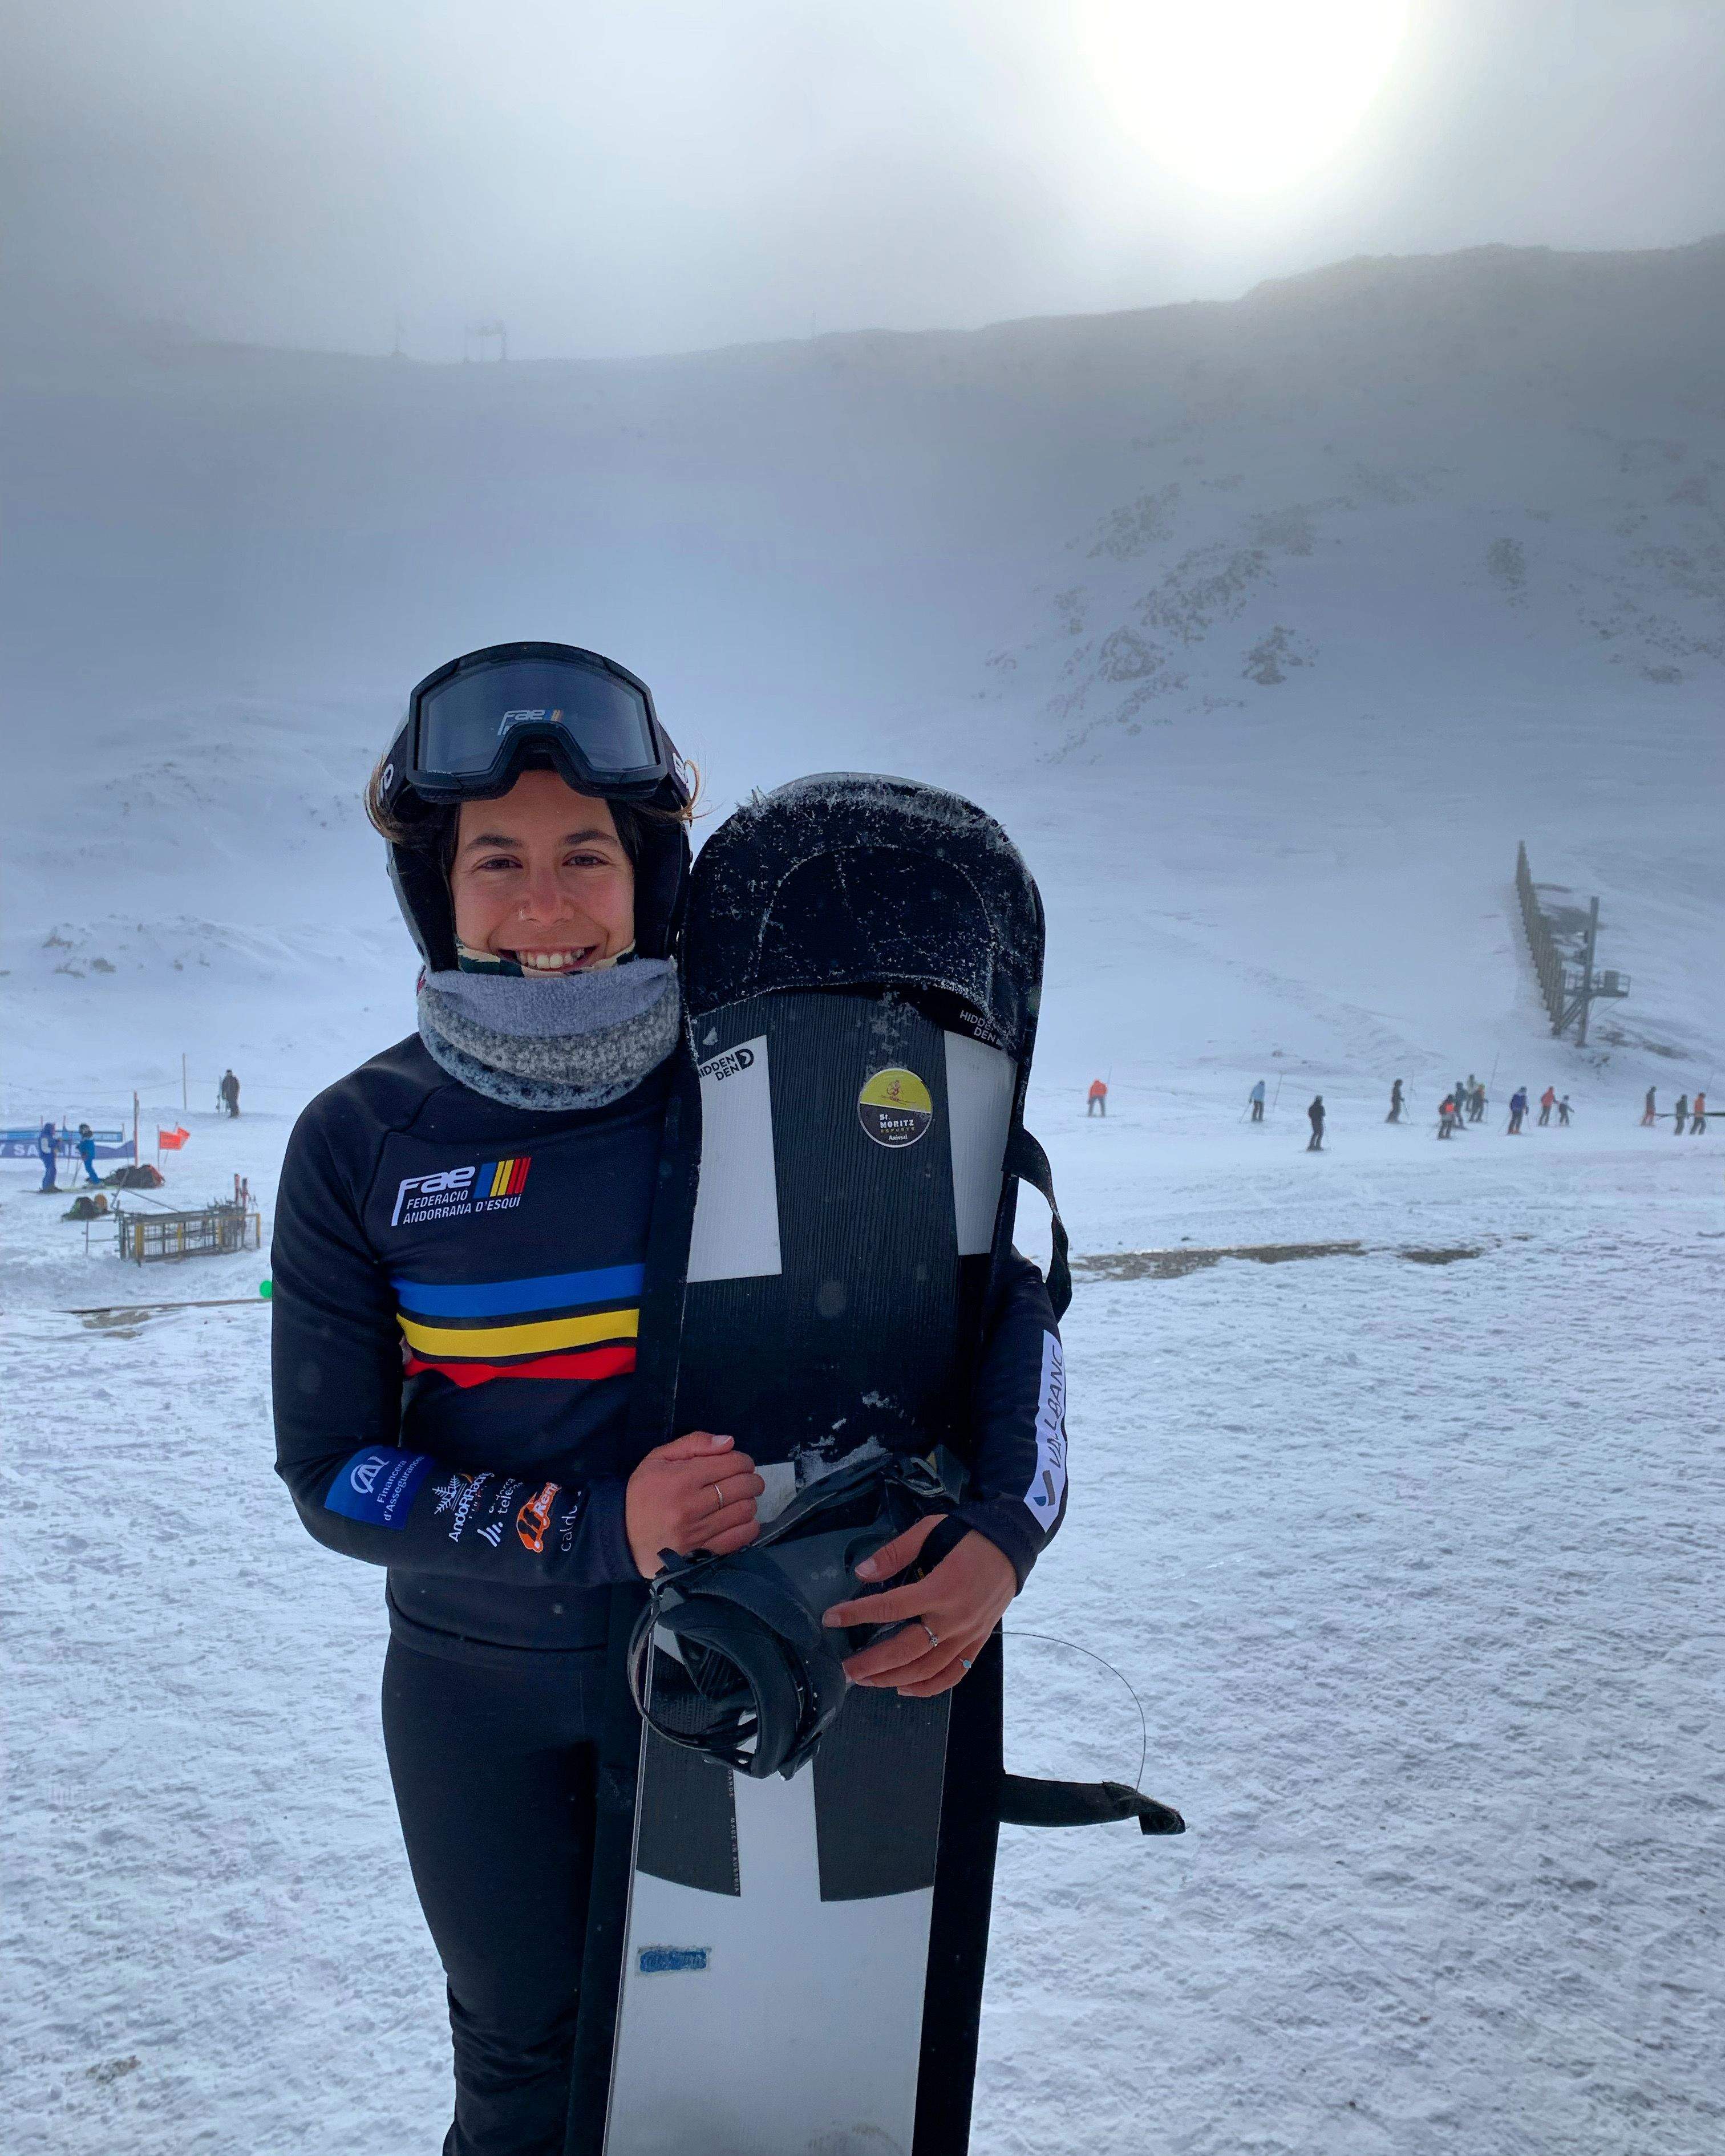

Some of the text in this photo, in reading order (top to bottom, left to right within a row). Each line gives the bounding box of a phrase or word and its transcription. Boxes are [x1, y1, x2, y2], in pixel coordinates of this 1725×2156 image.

[959, 1010, 994, 1031] HIDDE
[973, 1027, 997, 1043] DEN
[715, 1063, 740, 1081] DEN
[880, 1119, 914, 1129] MORITZ
[402, 1194, 521, 1225] ANDORRANA D'ESQUÍ
[406, 1188, 468, 1210] FEDERACIÓ
[376, 1460, 407, 1503] Financera
[560, 1492, 581, 1551] cald
